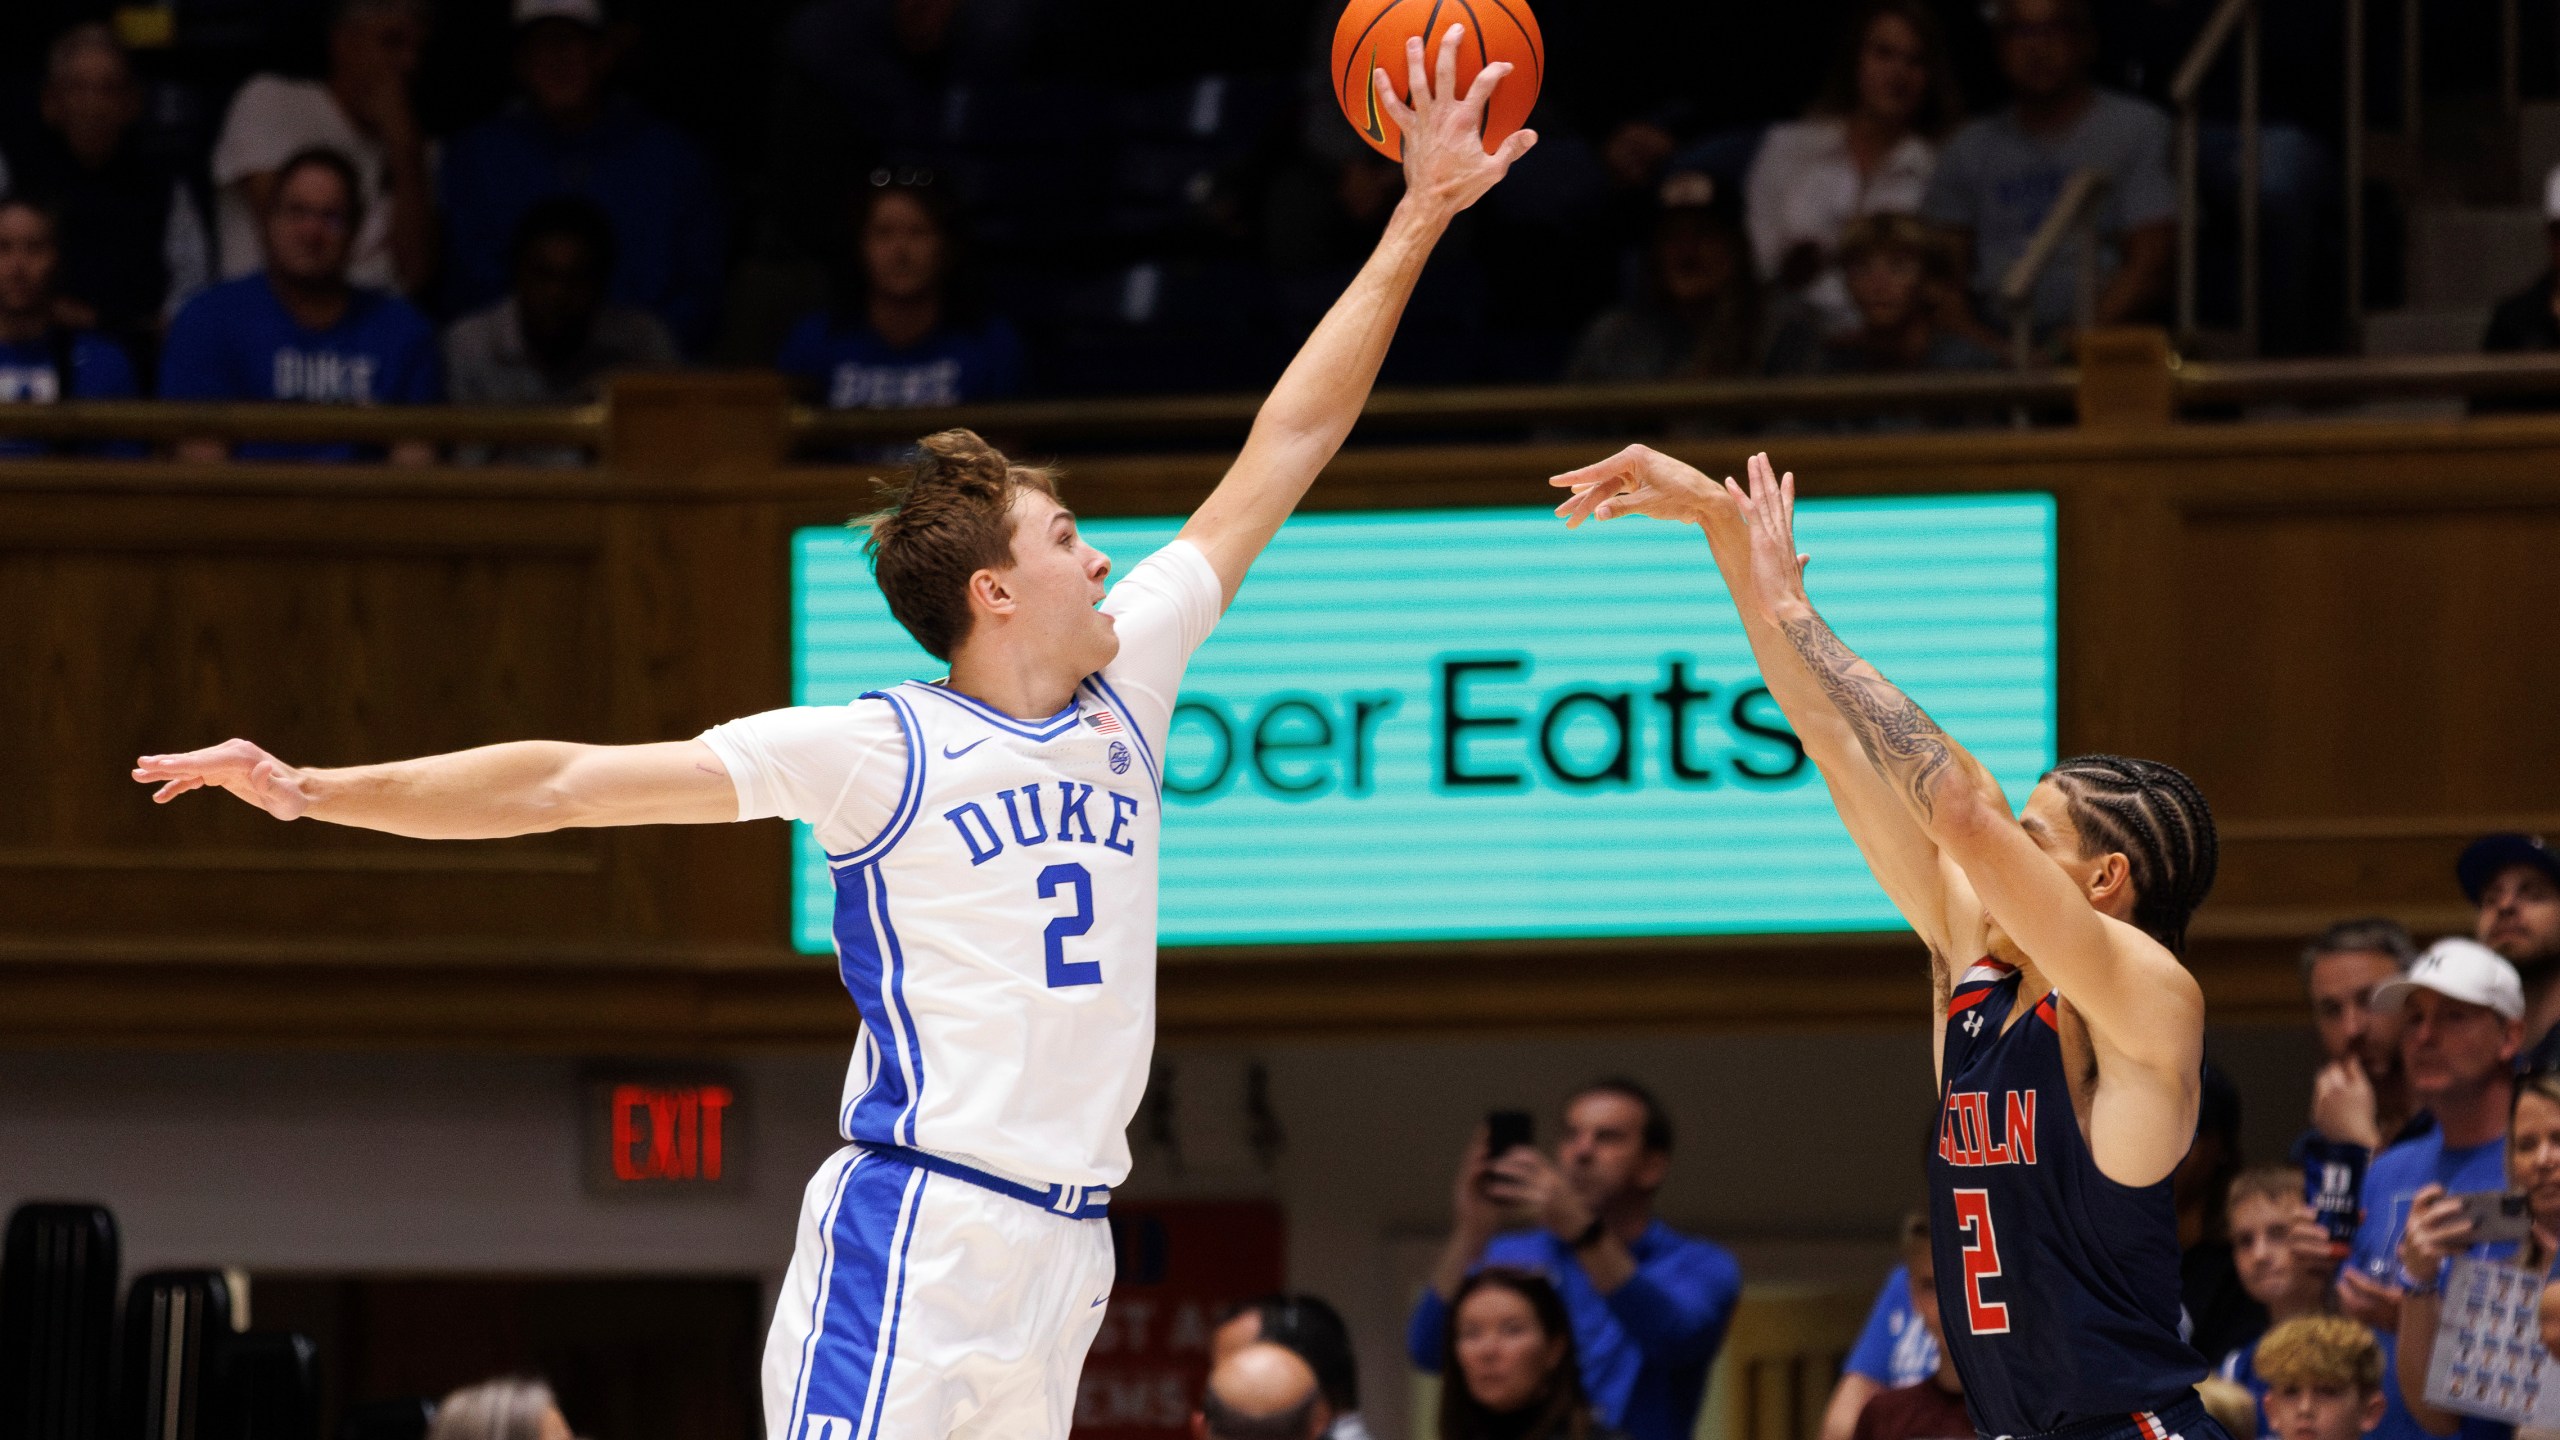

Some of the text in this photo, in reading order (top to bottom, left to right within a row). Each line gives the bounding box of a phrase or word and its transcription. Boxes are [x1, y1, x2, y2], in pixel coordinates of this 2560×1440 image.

[1442, 657, 1807, 787] Eats
[944, 781, 1138, 866] DUKE
[1037, 862, 1103, 988] 2
[612, 1084, 733, 1182] EXIT
[1953, 1188, 2010, 1335] 2
